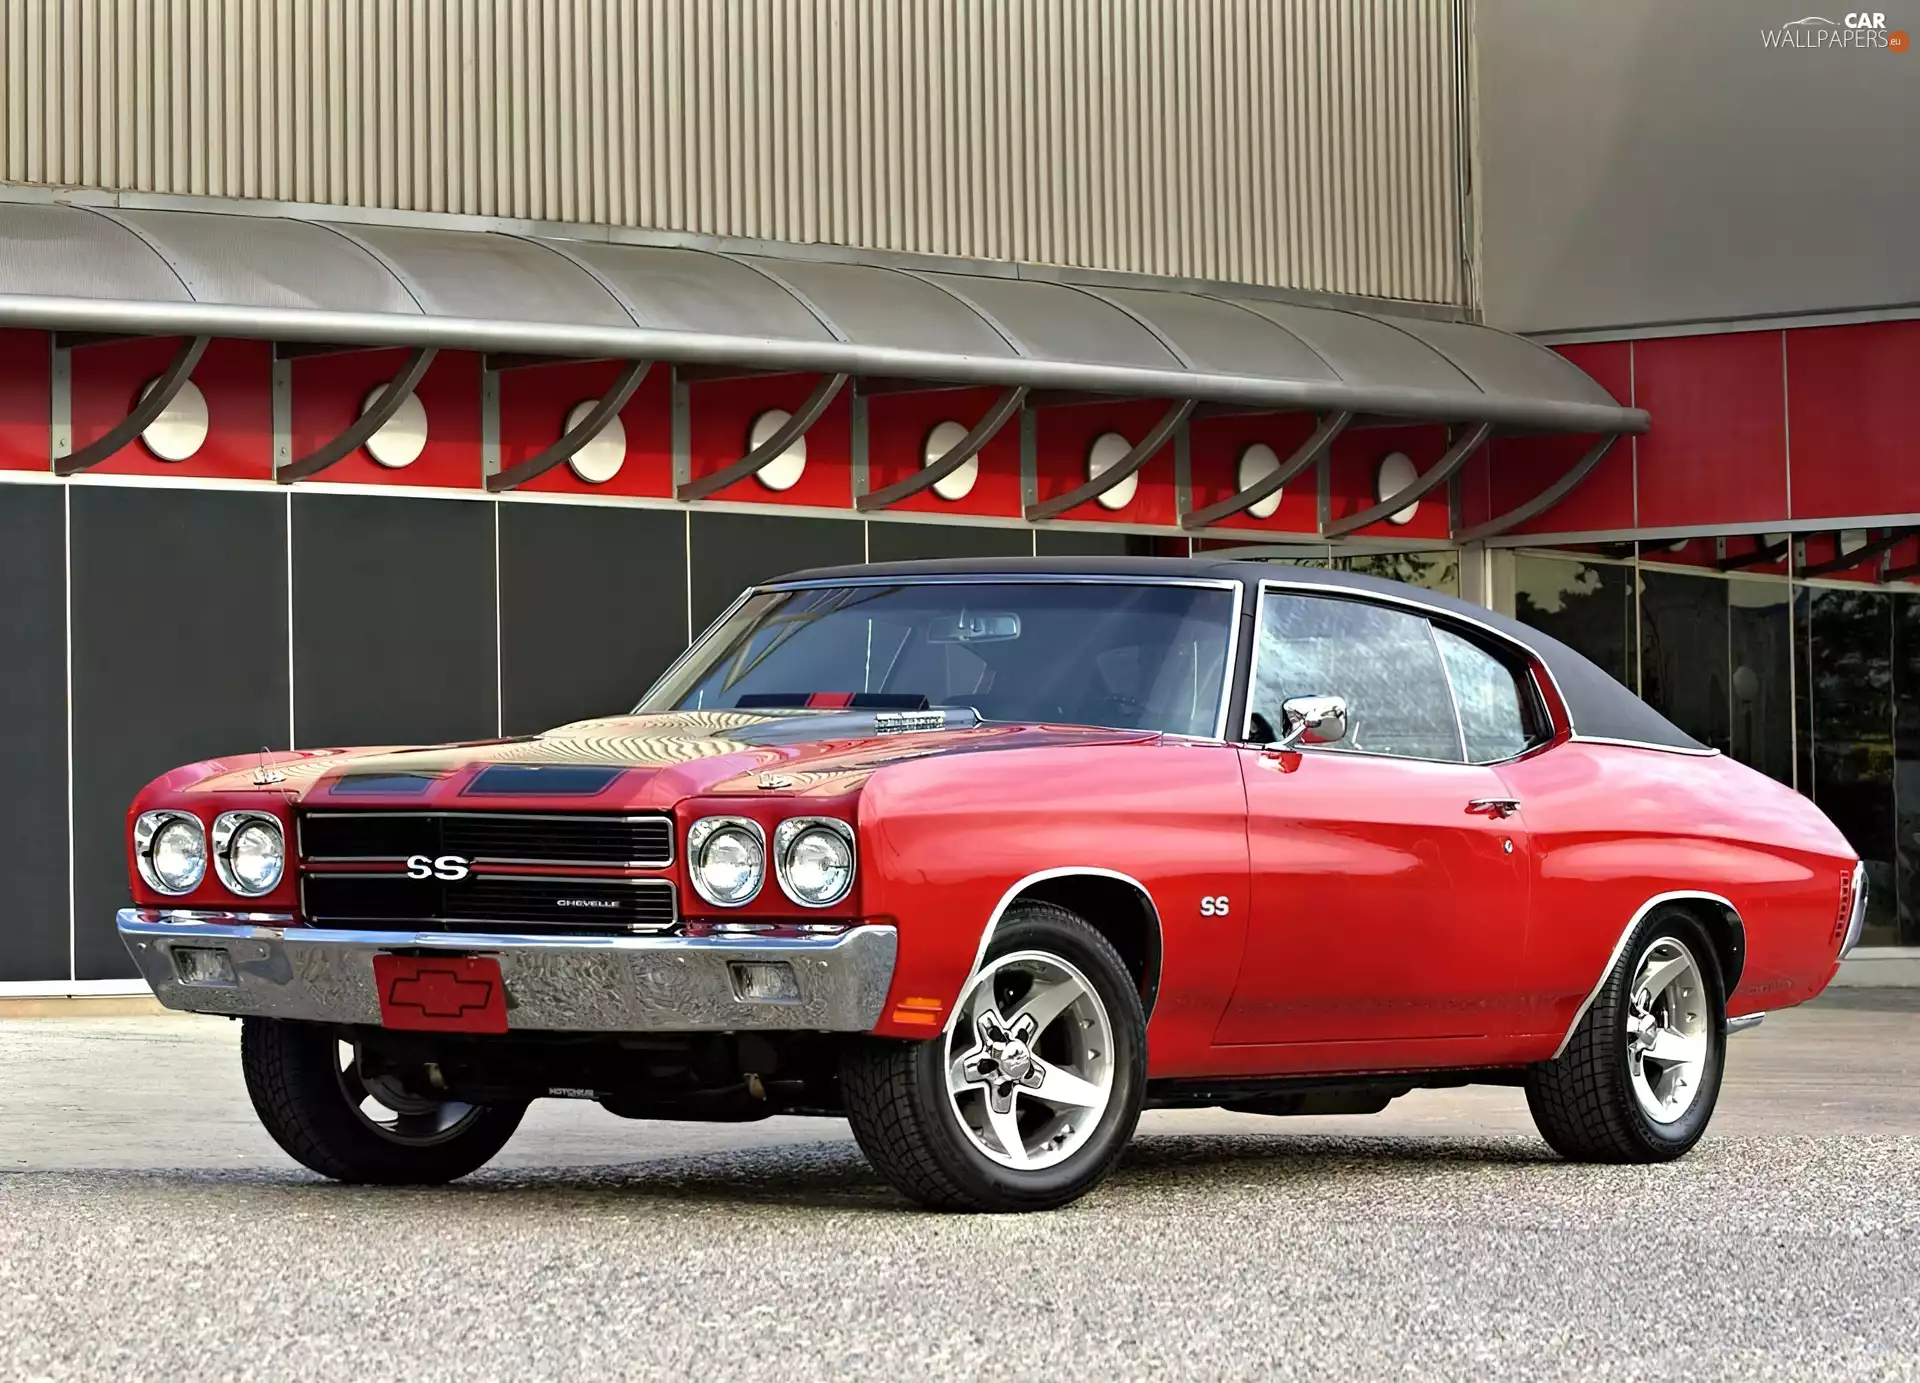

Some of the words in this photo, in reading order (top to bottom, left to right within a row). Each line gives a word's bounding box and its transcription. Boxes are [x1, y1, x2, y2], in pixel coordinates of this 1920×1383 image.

[407, 855, 471, 881] SS
[556, 899, 620, 908] CHEVELLE
[1200, 895, 1230, 917] SS
